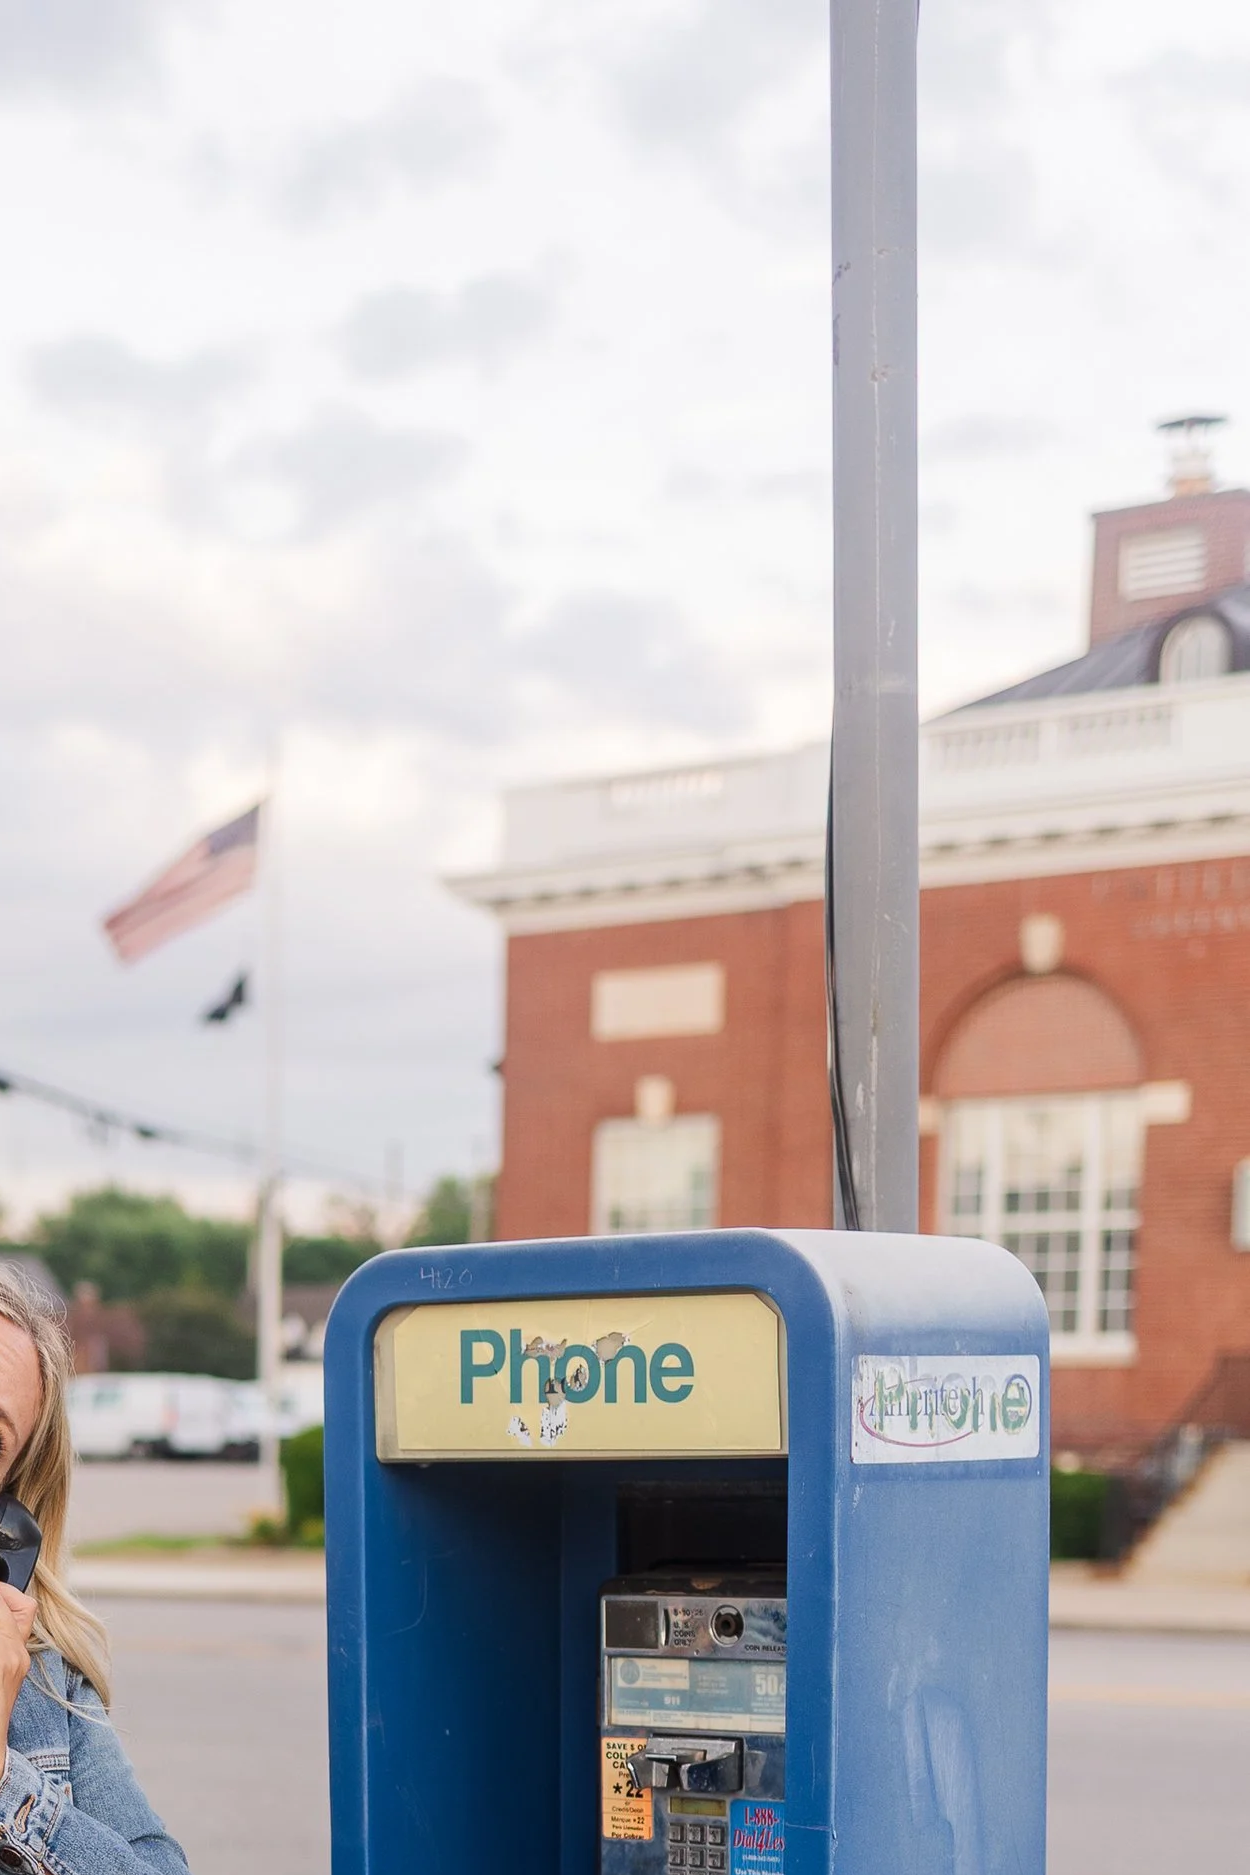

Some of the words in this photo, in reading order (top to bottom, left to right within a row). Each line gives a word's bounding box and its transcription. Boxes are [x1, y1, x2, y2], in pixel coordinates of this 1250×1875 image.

[459, 1327, 695, 1404] Phone
[663, 1695, 681, 1705] 911
[606, 1742, 627, 1751] SAVE
[744, 1807, 779, 1827] 1-888-
[733, 1827, 785, 1854] Dial4Les
